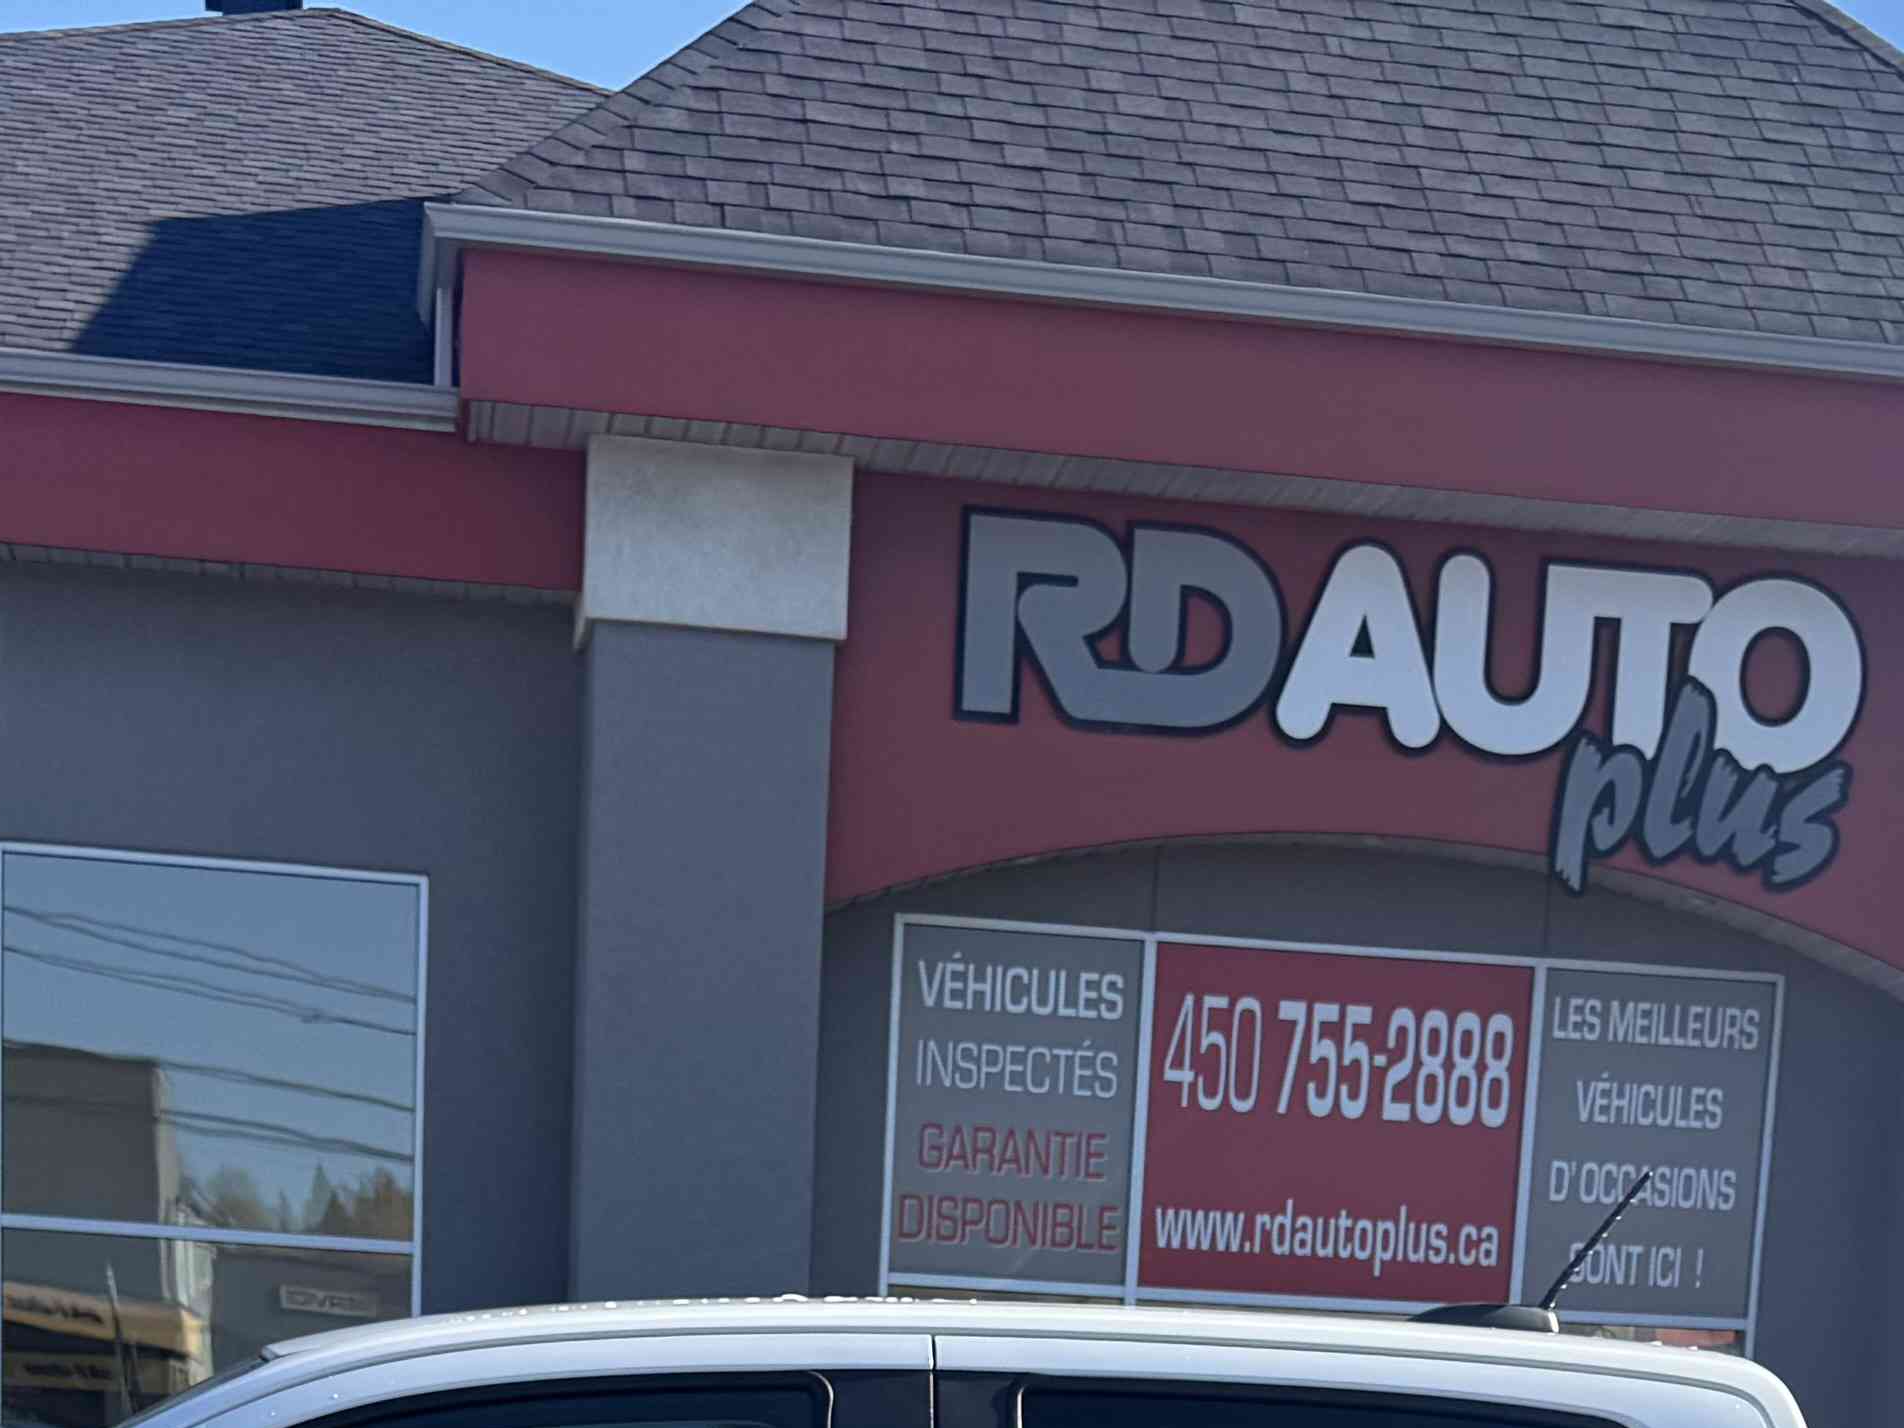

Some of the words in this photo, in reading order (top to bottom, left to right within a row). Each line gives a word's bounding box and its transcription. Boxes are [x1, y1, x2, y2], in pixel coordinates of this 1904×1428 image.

[1553, 676, 1851, 893] plus
[918, 952, 1124, 1020] VÉHICULES
[1552, 997, 1601, 1040] LES
[1607, 1000, 1760, 1050] MEILLEURS
[916, 1040, 1118, 1098] INSPECTÉS
[1163, 993, 1262, 1113] 450
[1277, 1000, 1514, 1128] 755-2888
[1576, 1071, 1723, 1129] VÉHICULES
[918, 1121, 1108, 1182] GARANTIE
[898, 1194, 1121, 1253] DISPONIBLE
[1155, 1199, 1498, 1277] www.rdautoplus.ca
[1648, 1247, 1681, 1288] ICI
